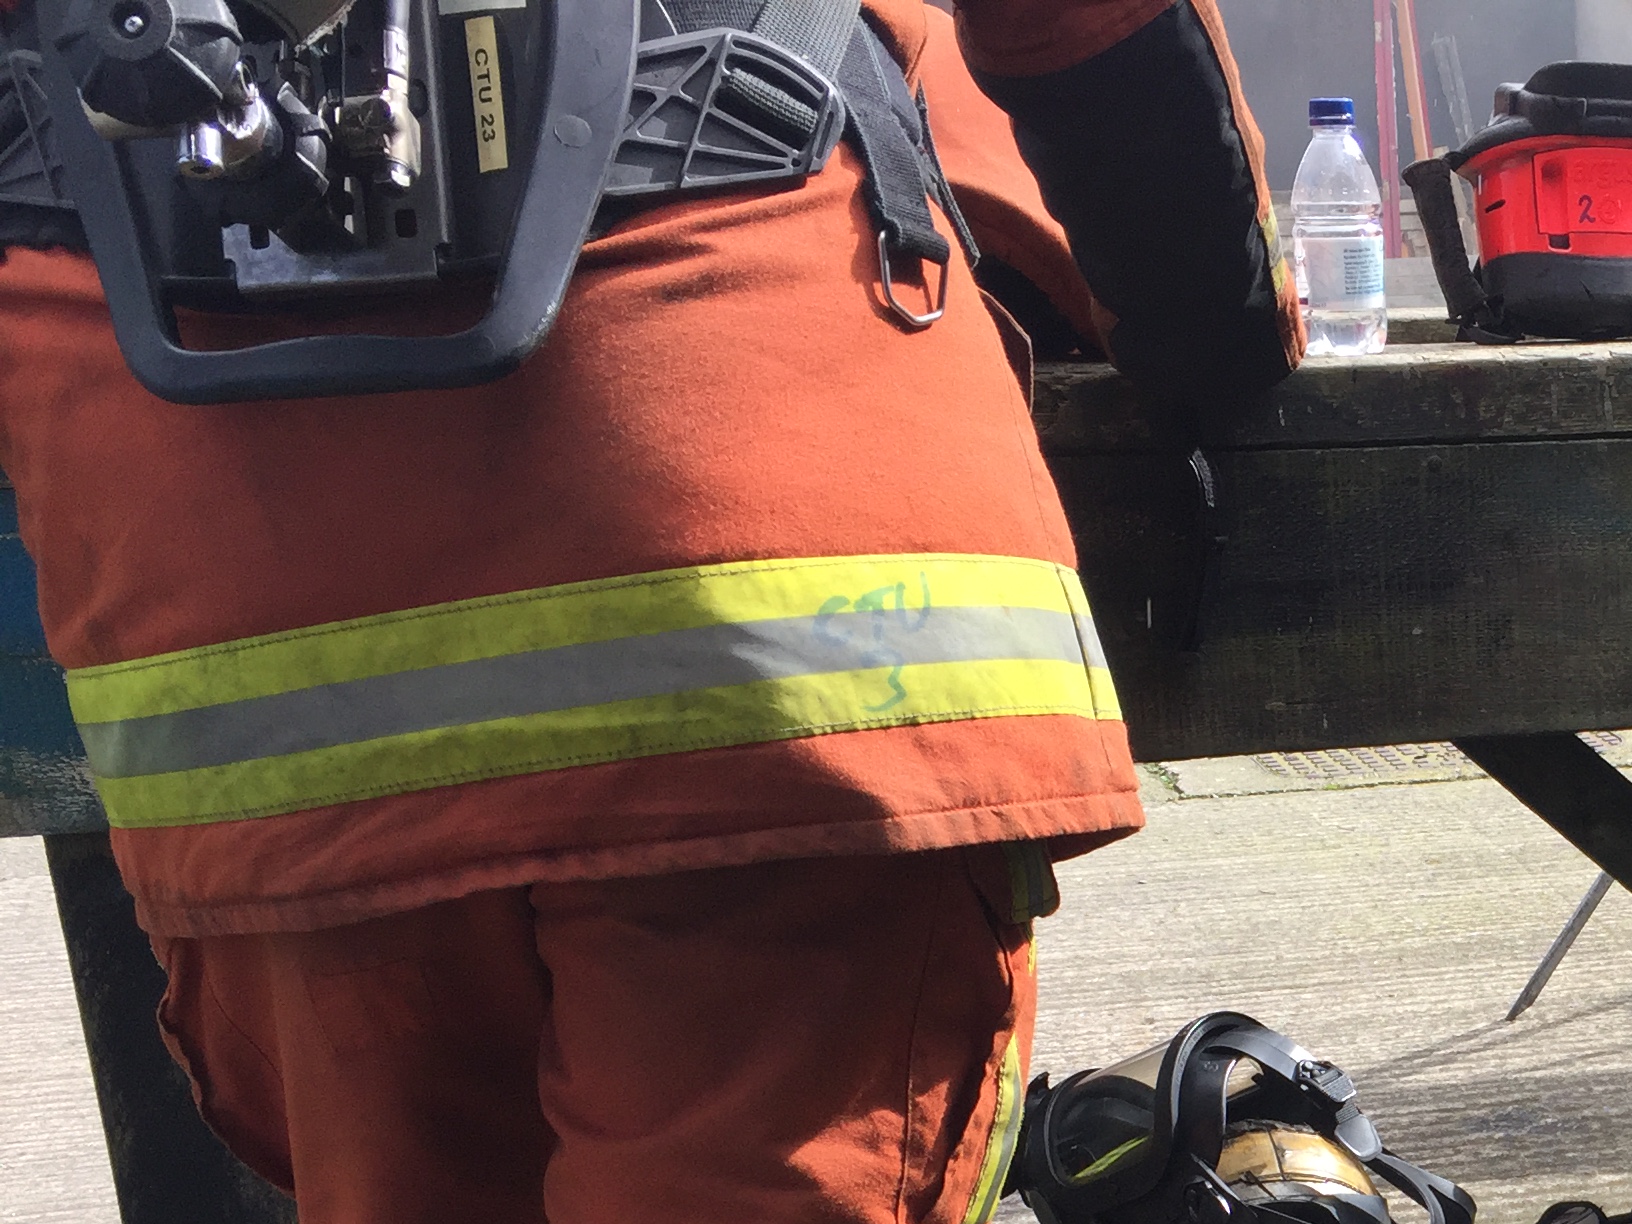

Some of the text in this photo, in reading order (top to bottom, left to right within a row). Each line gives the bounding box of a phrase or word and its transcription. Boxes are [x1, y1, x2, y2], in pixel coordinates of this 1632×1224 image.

[474, 48, 496, 143] CTU 23
[1578, 194, 1597, 224] 2
[811, 571, 932, 648] CTU
